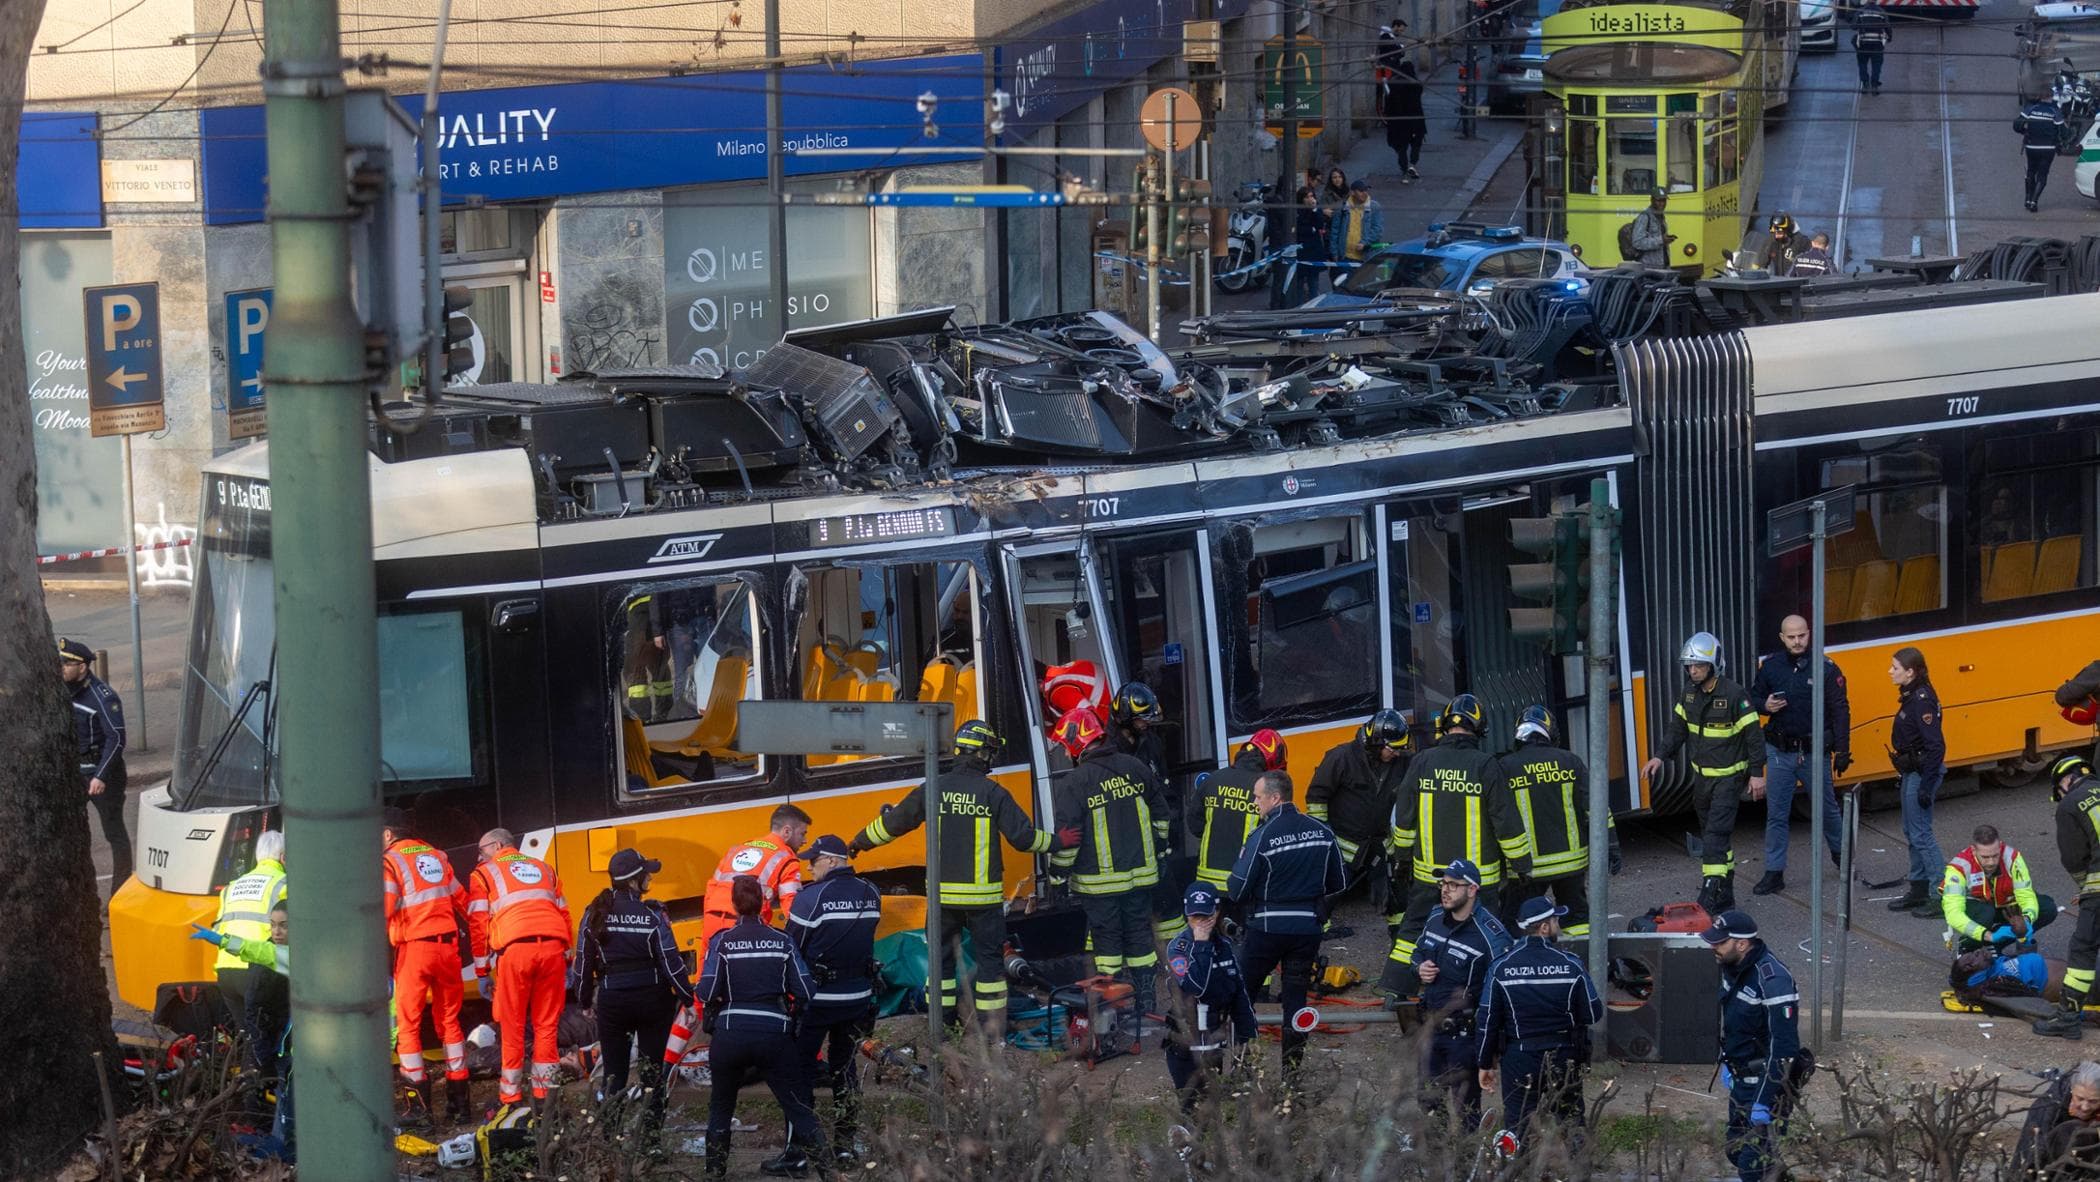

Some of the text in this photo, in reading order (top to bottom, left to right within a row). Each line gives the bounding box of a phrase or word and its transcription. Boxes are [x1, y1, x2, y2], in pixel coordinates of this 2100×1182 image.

[1590, 12, 1685, 32] idealista
[413, 108, 557, 148] UALITY
[717, 132, 849, 157] Milano epubblica
[468, 161, 482, 177] &
[489, 155, 559, 175] REHAB
[105, 181, 192, 190] VITTORIO VENETO
[732, 250, 764, 272] ME
[733, 293, 830, 321] PHSIO
[123, 338, 153, 349] a ore
[36, 350, 88, 377] Your
[1947, 396, 1979, 415] 7707
[217, 481, 226, 505] 9
[819, 519, 828, 541] 9
[927, 508, 945, 532] FS
[669, 541, 699, 555] ATM
[1434, 768, 1467, 781] VIGILI
[1524, 760, 1559, 775] VIGILI
[1217, 785, 1250, 800] VIGILI
[1442, 781, 1482, 794] FUOCO
[942, 791, 976, 805] VIGILI
[1087, 796, 1109, 809] DEL
[1204, 796, 1220, 807] DEL
[1269, 830, 1325, 848] POLIZIA LOCALE
[148, 846, 169, 868] 7707
[822, 900, 854, 911] POLIZIA
[620, 914, 650, 925] LOCALE
[755, 941, 784, 950] LOCALE
[1504, 964, 1570, 977] POLIZIA LOCALE
